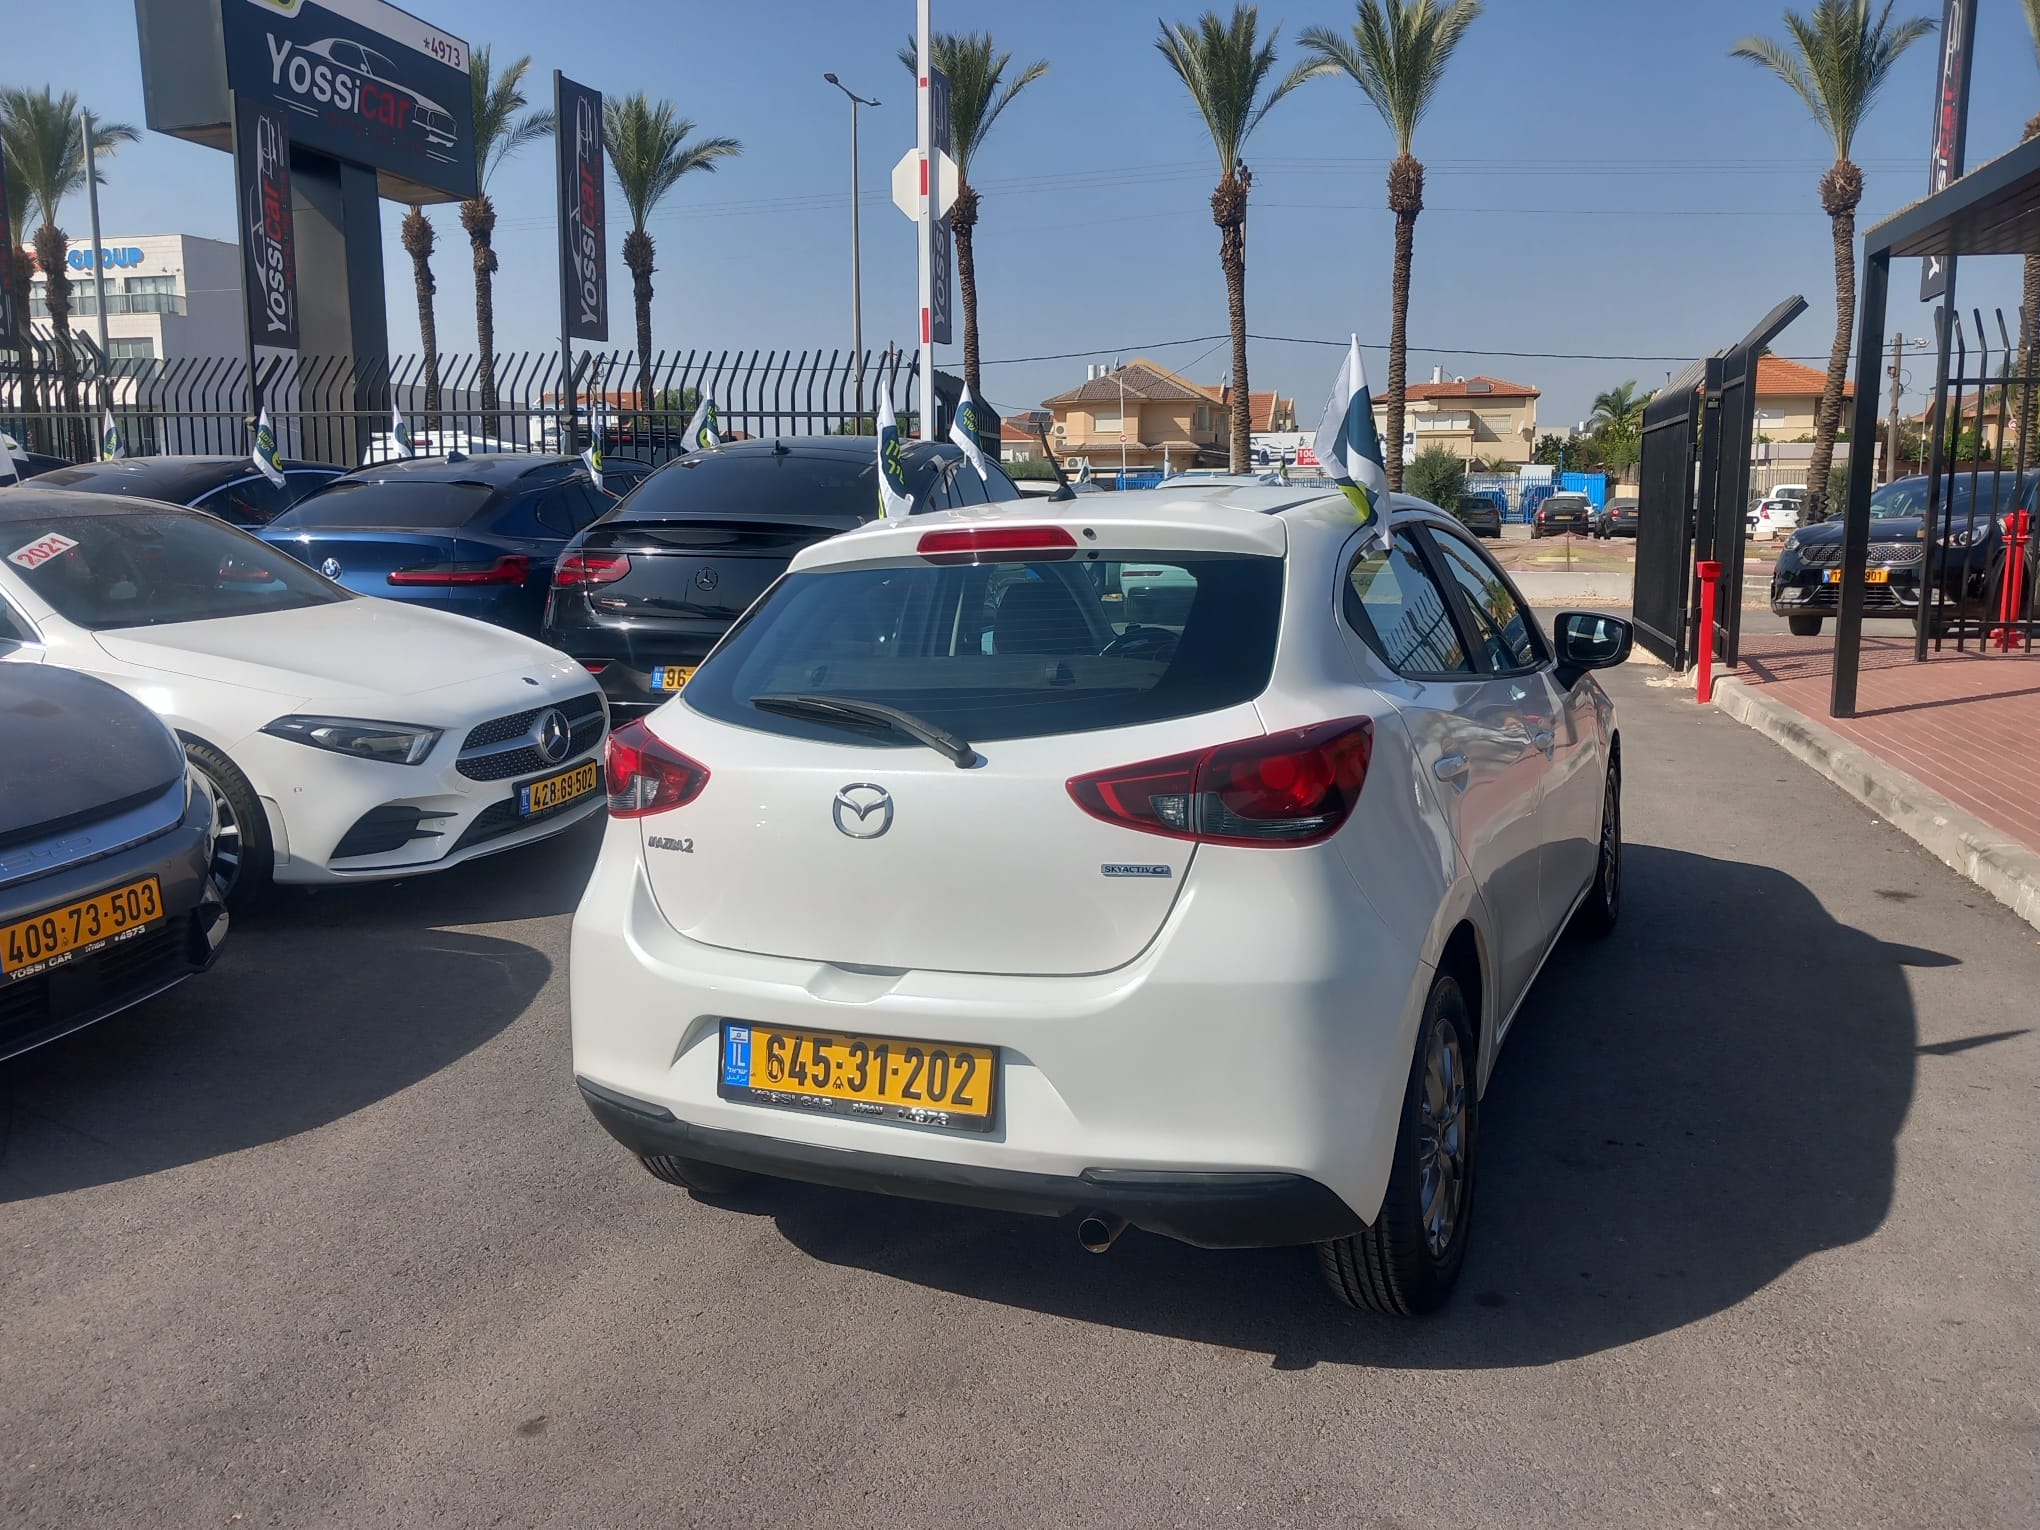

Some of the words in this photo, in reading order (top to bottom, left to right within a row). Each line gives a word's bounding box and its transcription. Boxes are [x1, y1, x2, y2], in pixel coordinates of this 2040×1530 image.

[17, 538, 70, 566] 2021
[9, 961, 46, 980] YOSSI
[49, 951, 74, 967] CAR
